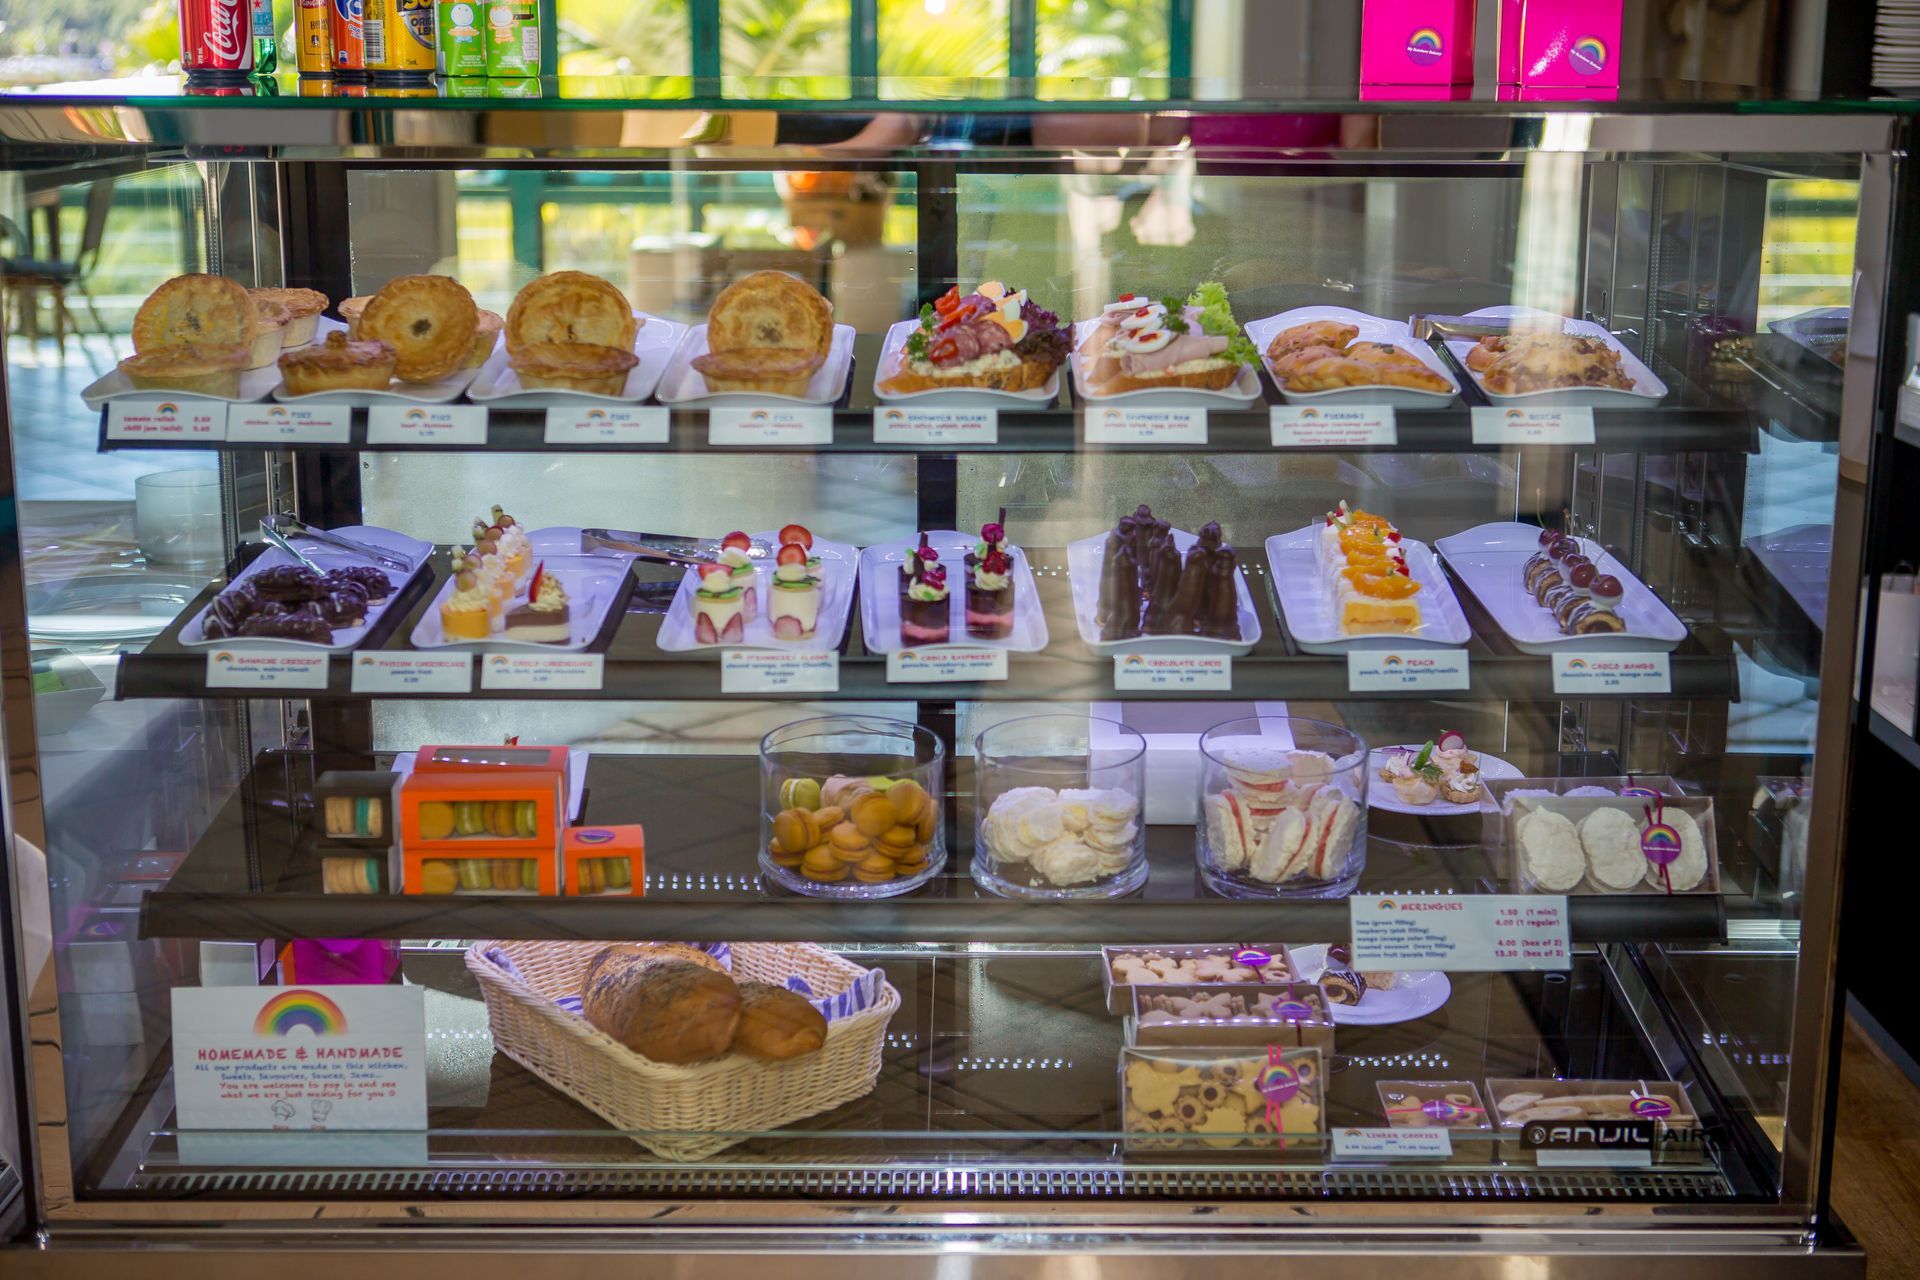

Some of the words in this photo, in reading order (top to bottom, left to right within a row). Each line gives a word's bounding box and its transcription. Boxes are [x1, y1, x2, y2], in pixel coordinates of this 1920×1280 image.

[1401, 903, 1463, 911] MERINGUES
[1526, 919, 1560, 927] regular)
[198, 1048, 288, 1061] HOMEMADE
[296, 1046, 308, 1061] &
[316, 1047, 403, 1059] HANDMADE
[235, 1063, 277, 1073] products
[221, 1073, 255, 1081] Sweets,
[259, 1073, 307, 1081] Savouries,
[312, 1072, 346, 1080] Sauces,
[323, 1082, 340, 1091] pop
[358, 1080, 377, 1088] and
[284, 1090, 302, 1100] just
[307, 1090, 344, 1099] making
[347, 1089, 362, 1098] for
[366, 1091, 384, 1101] you
[1662, 1128, 1706, 1143] AIR
